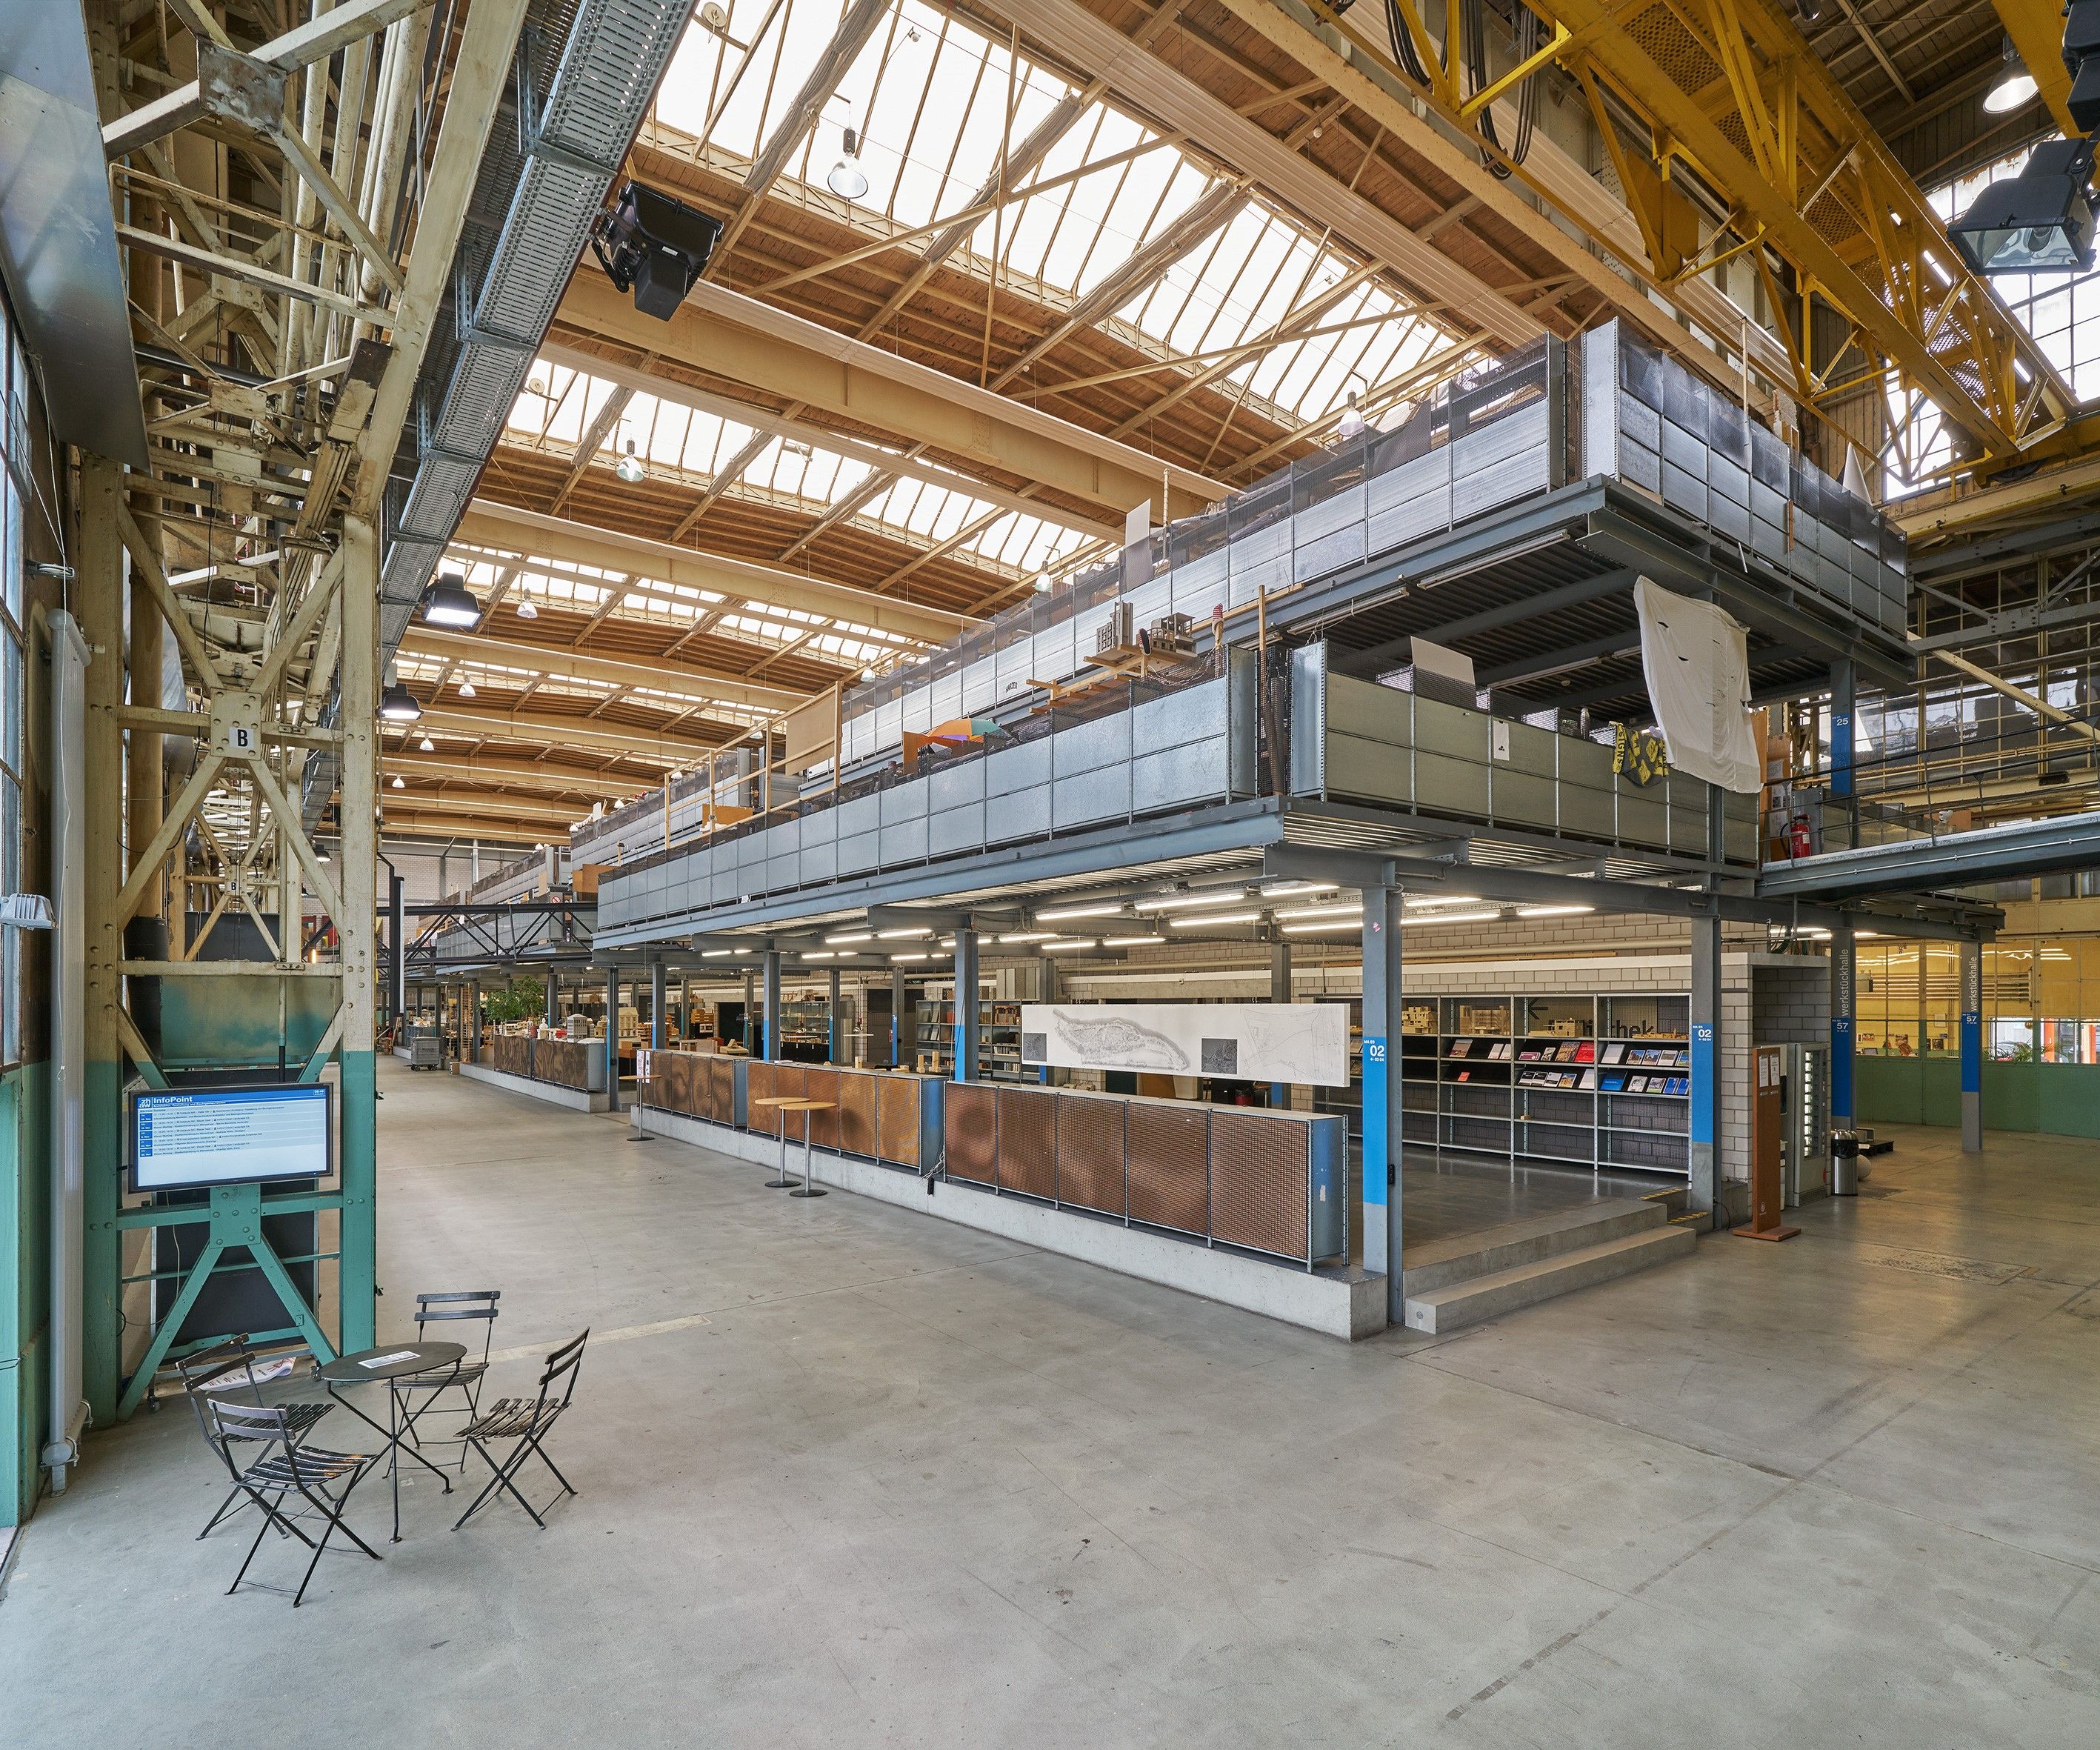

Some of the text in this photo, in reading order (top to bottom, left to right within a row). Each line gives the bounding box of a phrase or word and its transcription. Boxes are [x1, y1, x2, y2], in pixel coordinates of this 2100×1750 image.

[1836, 717, 1849, 726] 25
[237, 729, 248, 747] B
[1617, 731, 1625, 764] SIGNS
[231, 882, 236, 891] B
[1839, 949, 1849, 1017] werkstückhalle
[1969, 956, 1977, 1012] werkstückhalle
[1698, 1029, 1712, 1038] 02
[1370, 1045, 1385, 1057] 02
[153, 1096, 193, 1104] InfoPoint
